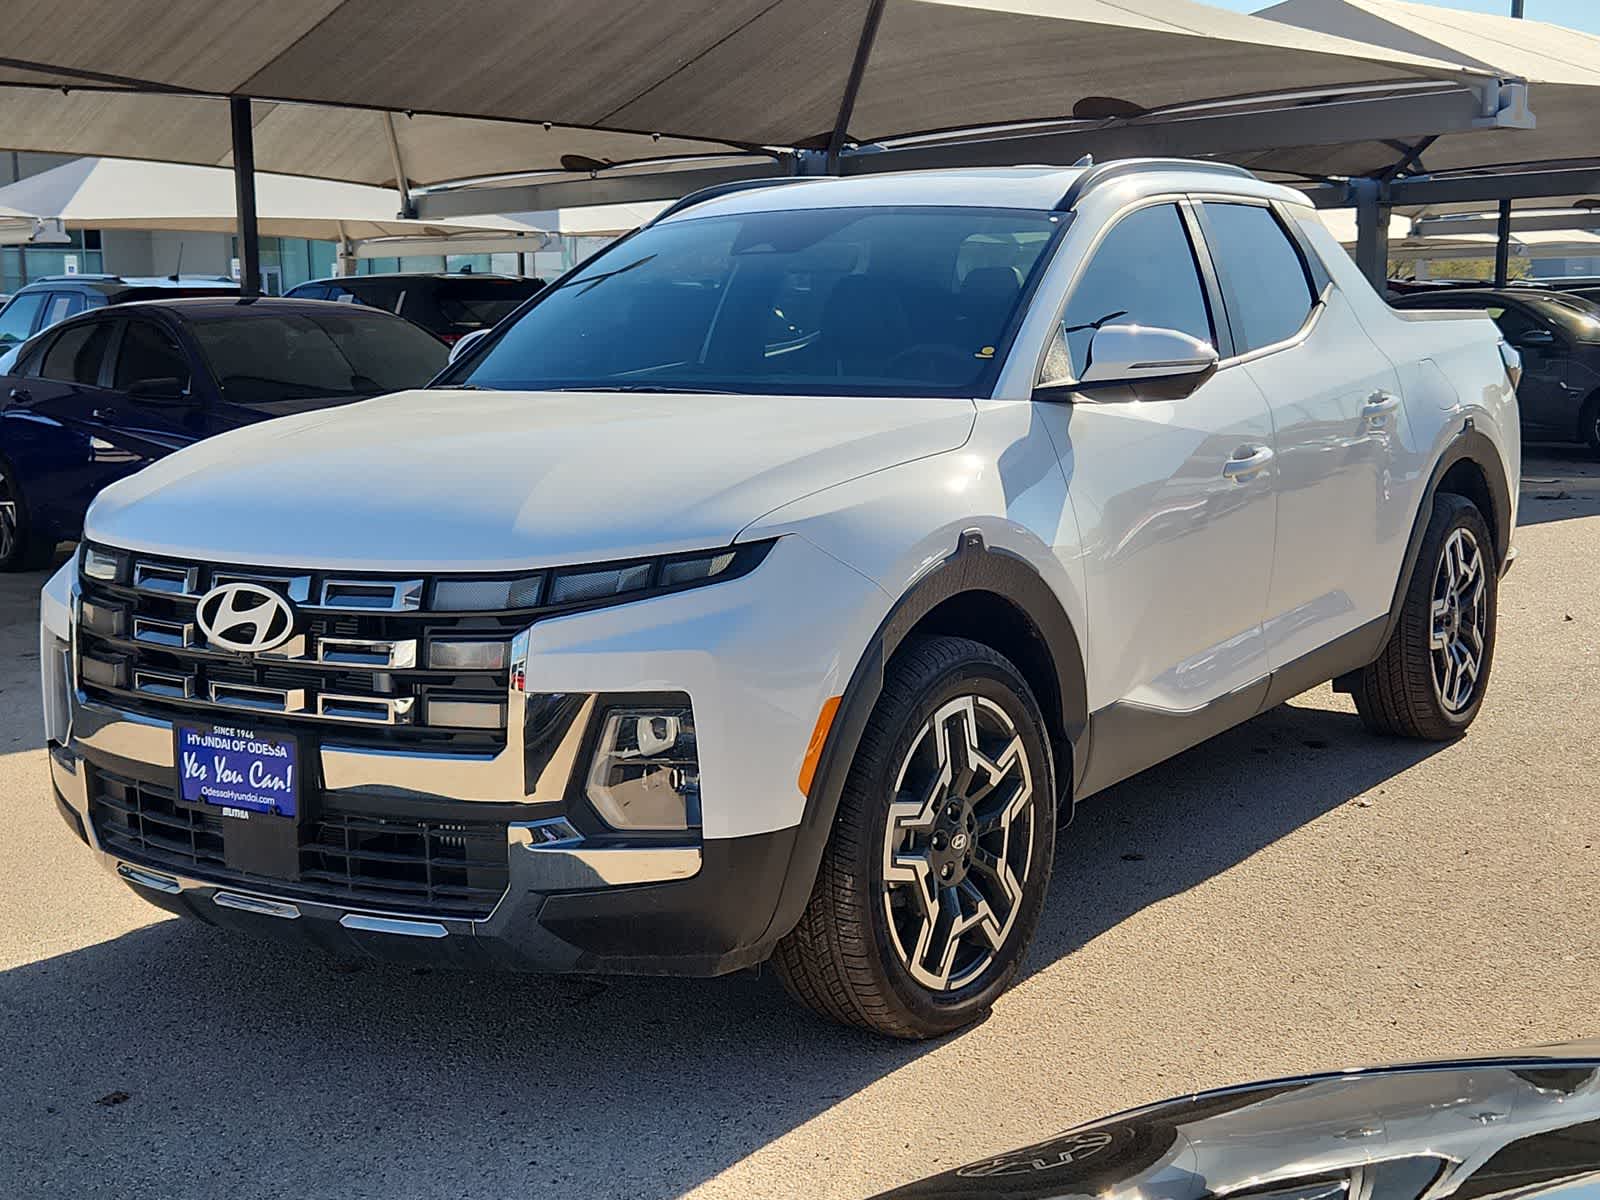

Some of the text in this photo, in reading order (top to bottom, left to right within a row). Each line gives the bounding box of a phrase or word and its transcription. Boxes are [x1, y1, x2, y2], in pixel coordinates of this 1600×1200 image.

[213, 725, 254, 739] SINCE 1946
[187, 734, 288, 757] HYUNDAI OF ODESSA
[183, 752, 293, 792] Yes You Can!
[201, 786, 275, 805] OdessaHyundai.com
